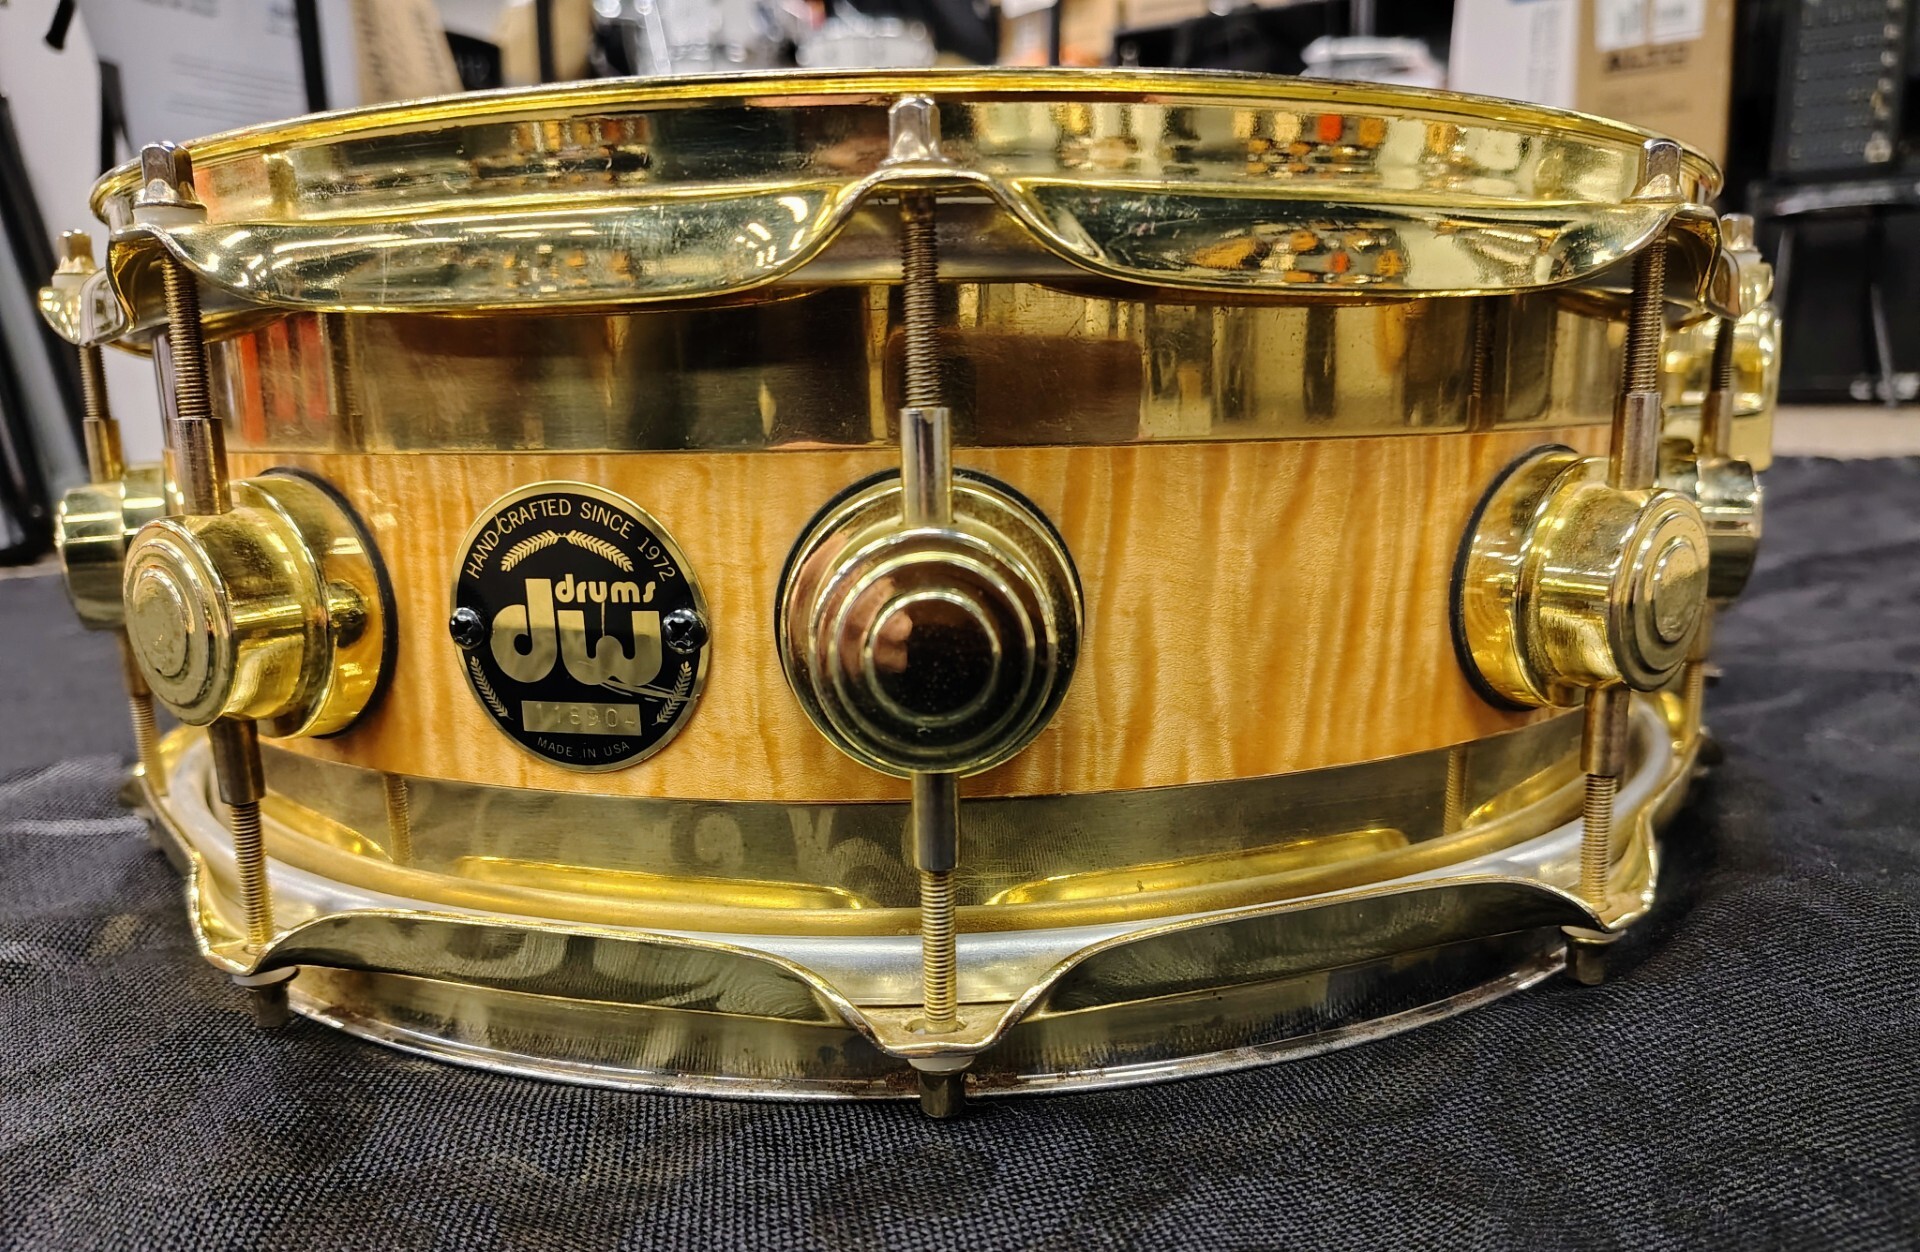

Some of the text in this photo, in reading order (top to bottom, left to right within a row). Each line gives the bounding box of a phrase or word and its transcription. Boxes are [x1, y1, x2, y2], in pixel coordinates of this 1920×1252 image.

[466, 498, 676, 582] HANDCRAFTED SINCE 1972
[554, 573, 656, 604] drums
[537, 737, 630, 758] MADE IN USA
